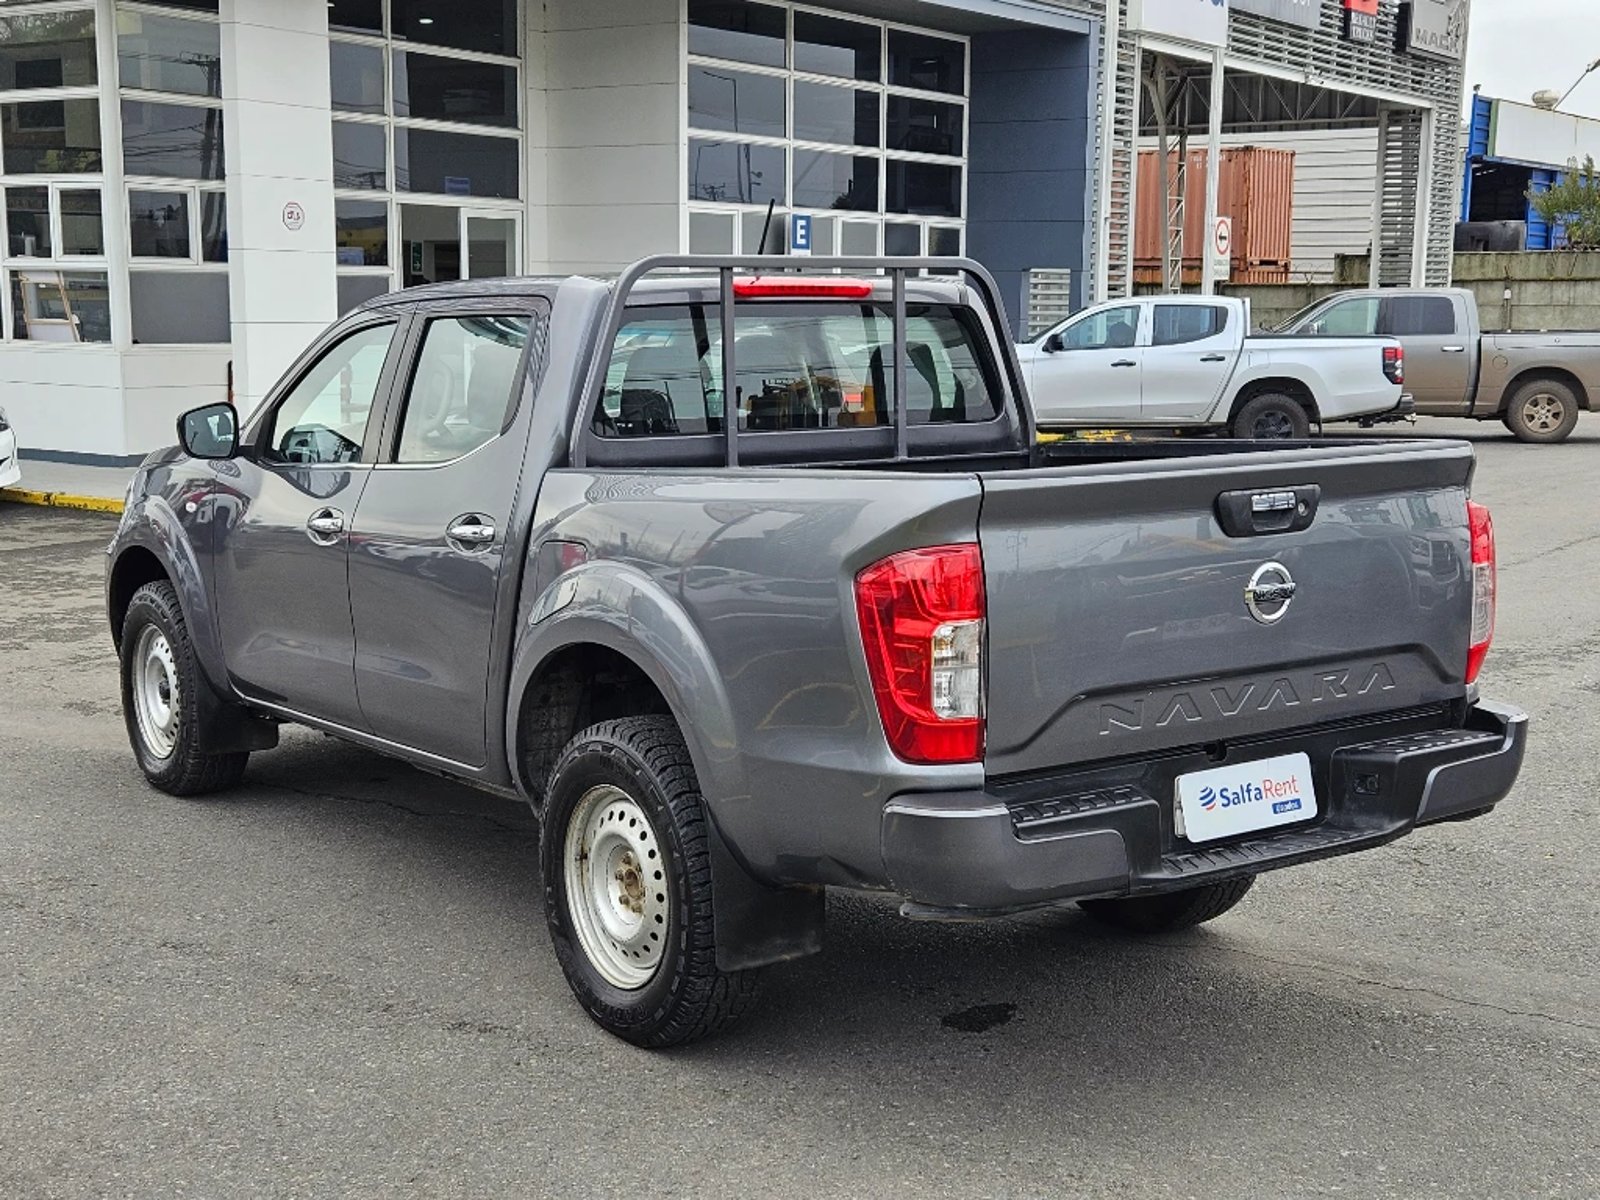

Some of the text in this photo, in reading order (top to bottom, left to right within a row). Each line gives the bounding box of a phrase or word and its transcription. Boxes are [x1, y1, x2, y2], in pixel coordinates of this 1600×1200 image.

[797, 220, 806, 244] E
[1100, 663, 1395, 734] NAVARA
[1220, 775, 1299, 807] SalfaRent
